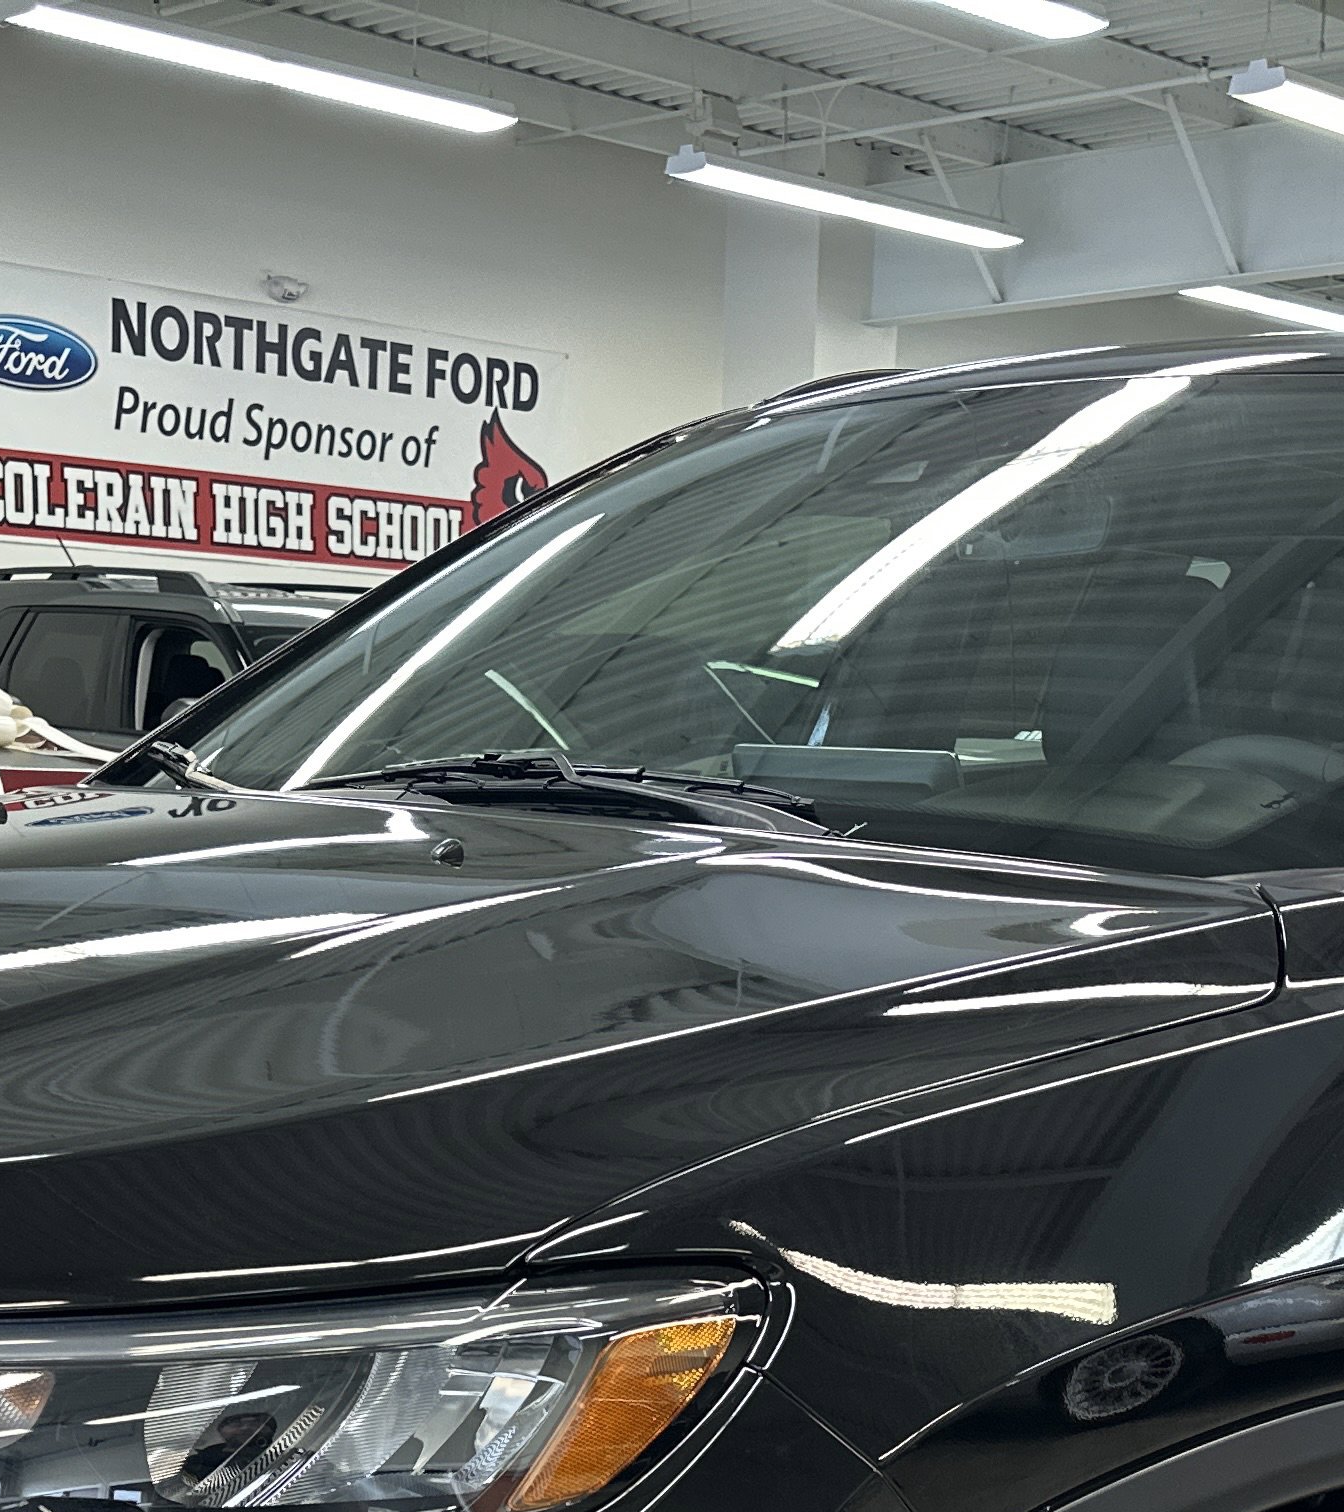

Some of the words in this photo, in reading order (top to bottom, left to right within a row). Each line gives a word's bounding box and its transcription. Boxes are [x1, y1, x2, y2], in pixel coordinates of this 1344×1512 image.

[110, 297, 413, 396] NORTHGATE
[425, 348, 540, 412] FORD
[114, 386, 235, 444] Proud
[242, 403, 394, 462] Sponsor
[401, 426, 440, 468] of
[212, 479, 316, 553] HIGH
